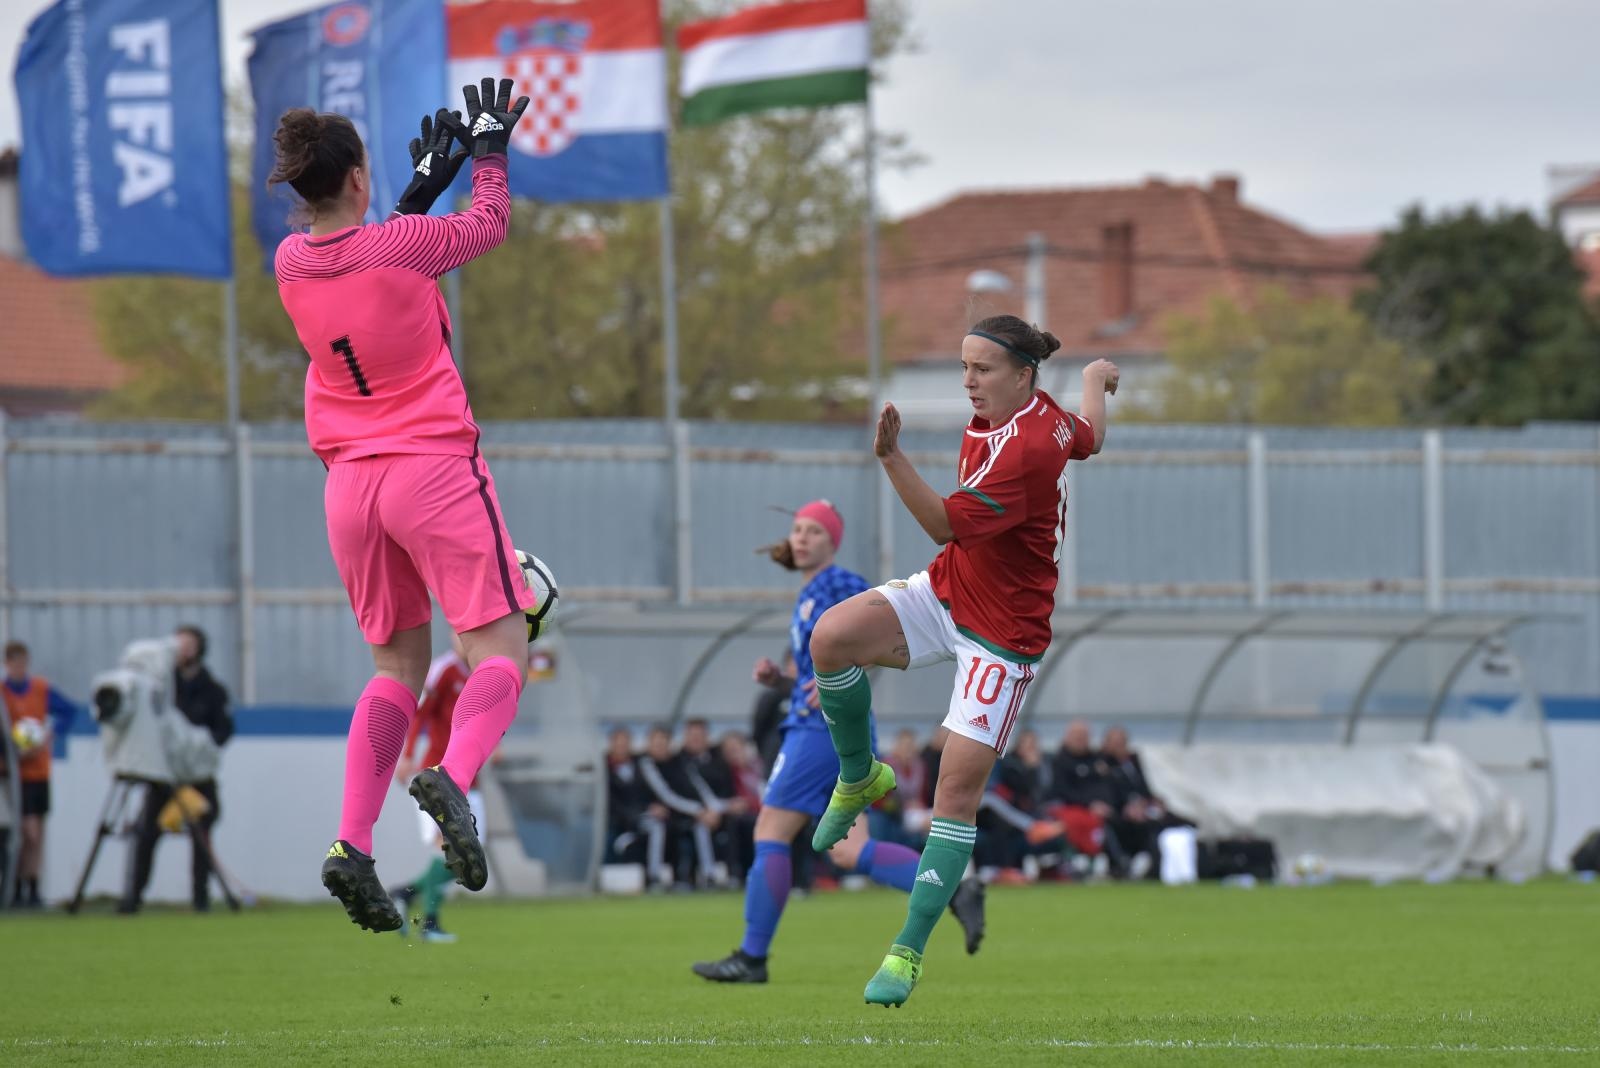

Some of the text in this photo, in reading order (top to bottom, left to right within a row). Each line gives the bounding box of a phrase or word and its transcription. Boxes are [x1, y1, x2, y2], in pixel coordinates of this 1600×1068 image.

[104, 18, 174, 208] FIFA
[471, 122, 505, 137] adidas
[329, 335, 373, 397] 1
[963, 656, 1007, 705] 10
[968, 720, 991, 732] adidas
